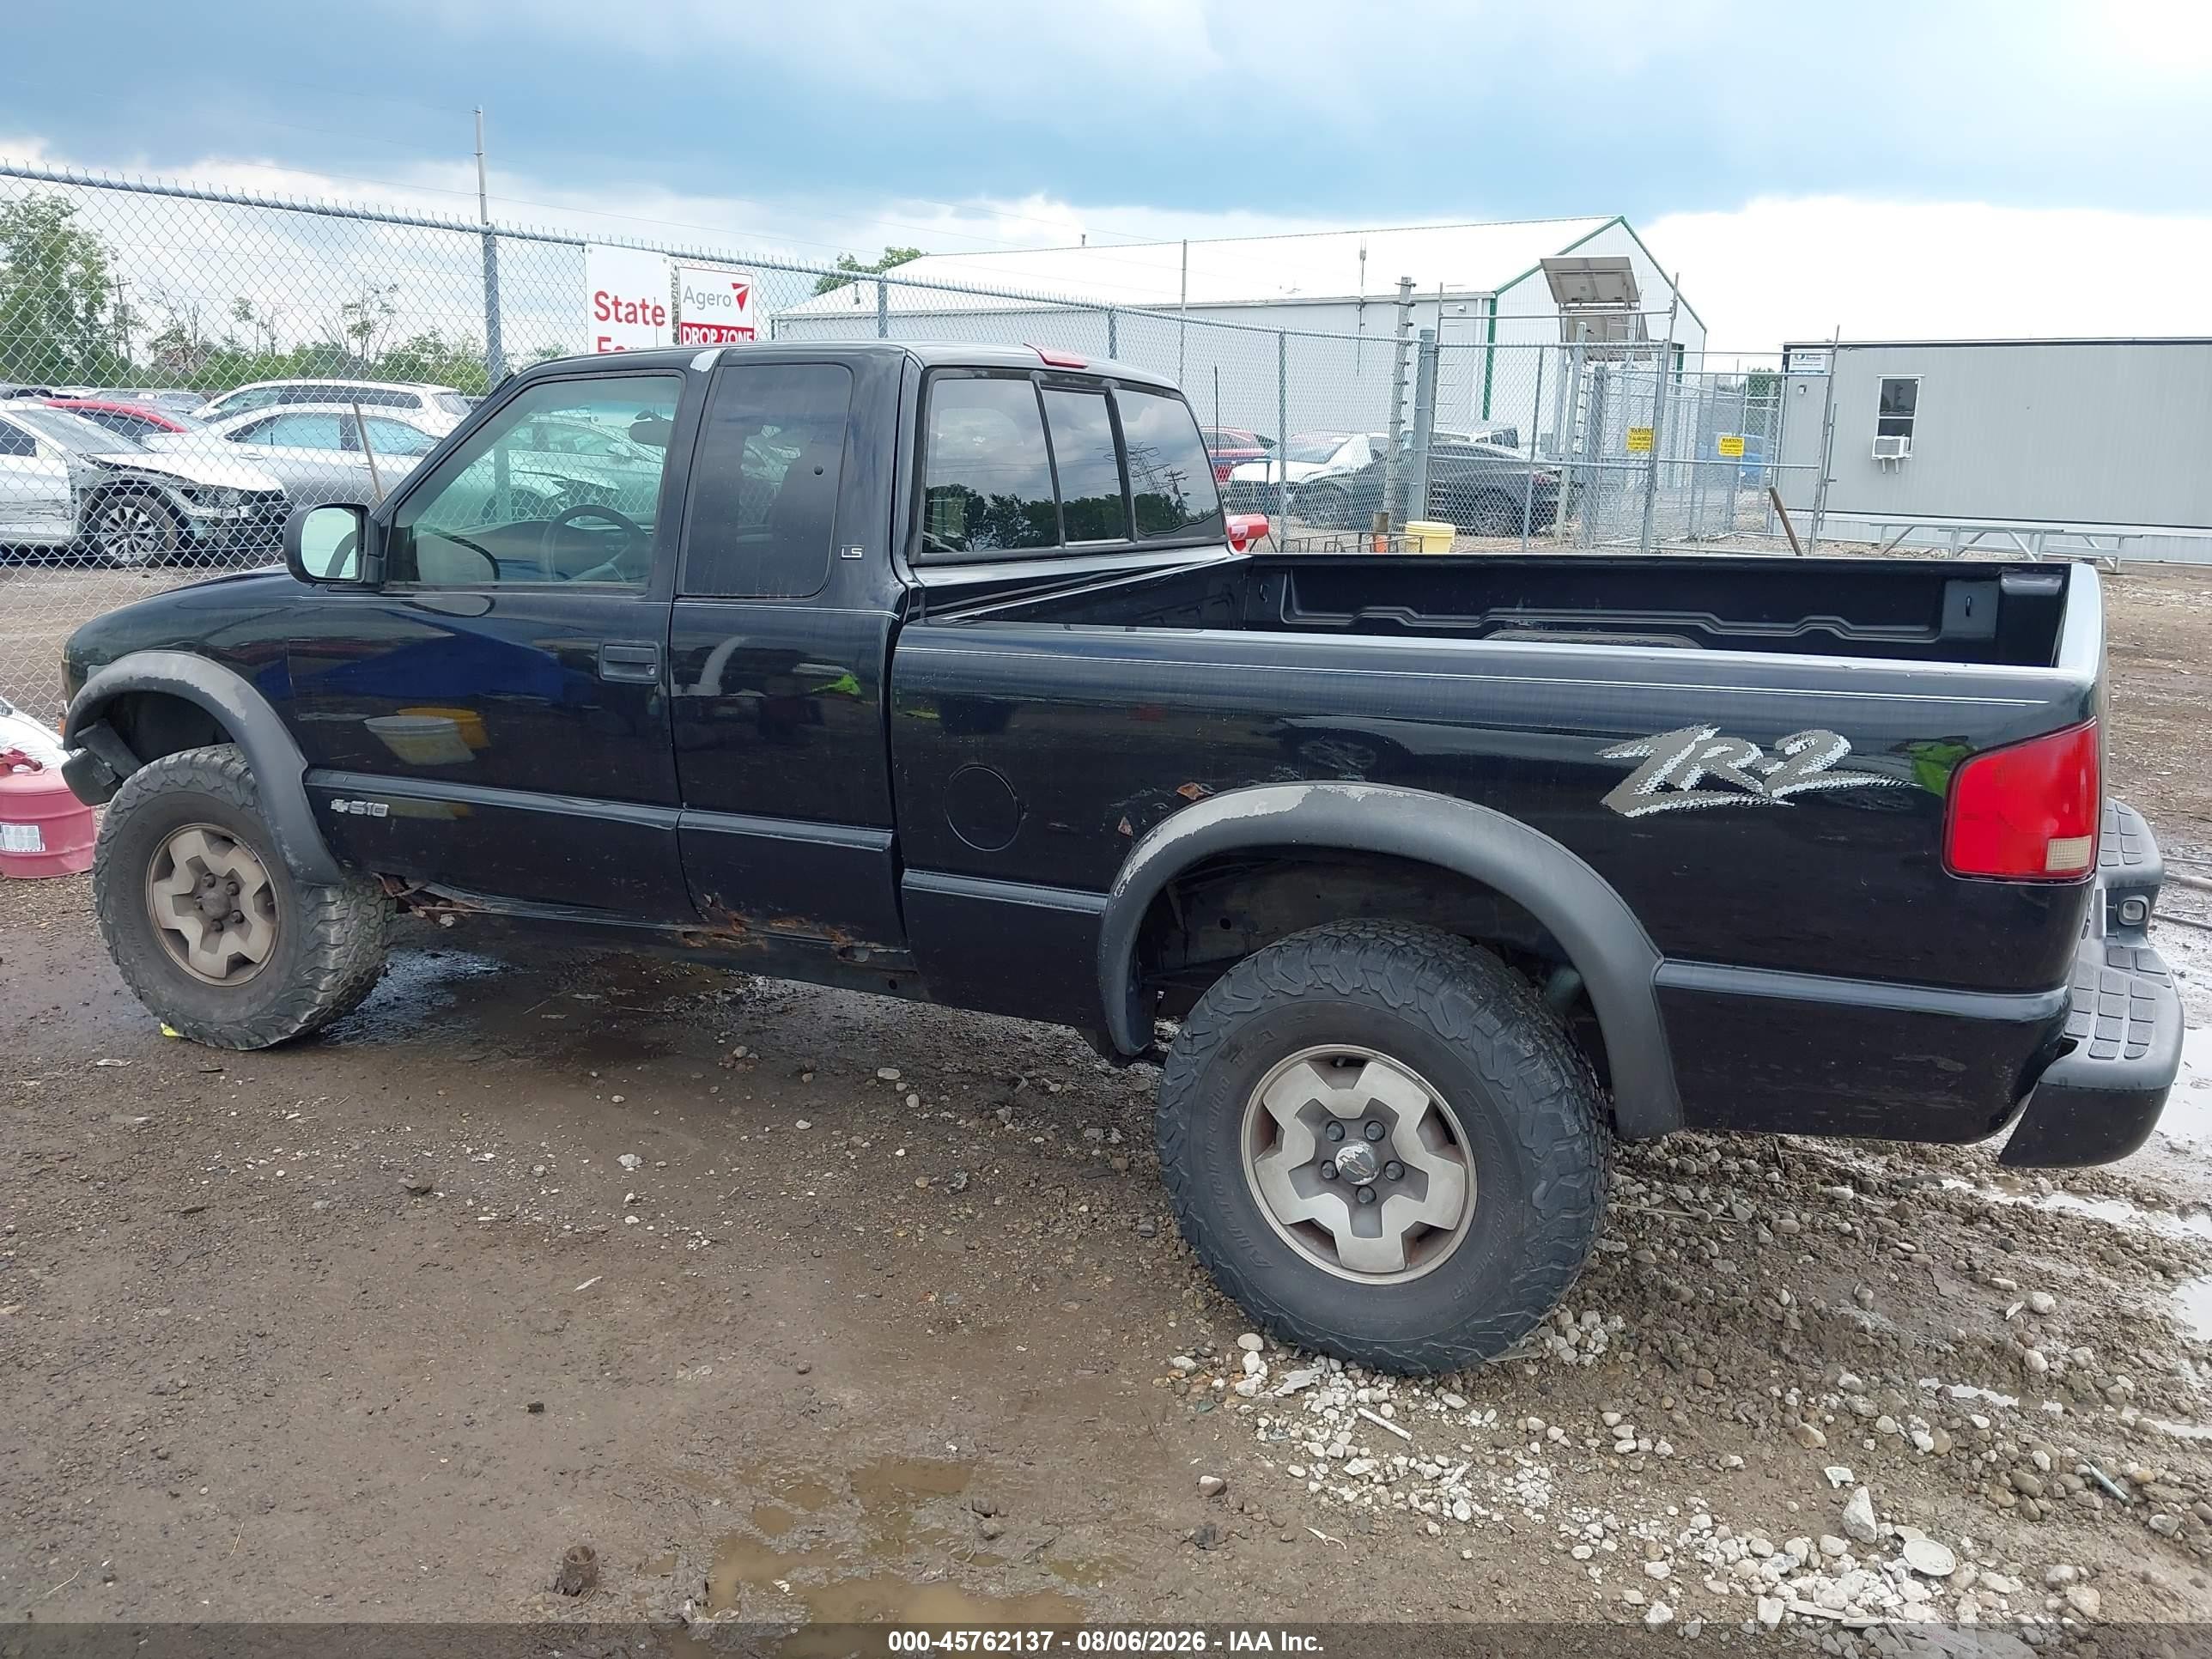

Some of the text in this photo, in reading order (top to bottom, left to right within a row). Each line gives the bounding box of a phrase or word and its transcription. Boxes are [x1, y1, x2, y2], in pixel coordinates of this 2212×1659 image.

[593, 291, 665, 326] State
[683, 286, 732, 310] Agero
[683, 325, 718, 344] DROP
[842, 548, 862, 557] LS
[1594, 723, 1921, 818] ZR2
